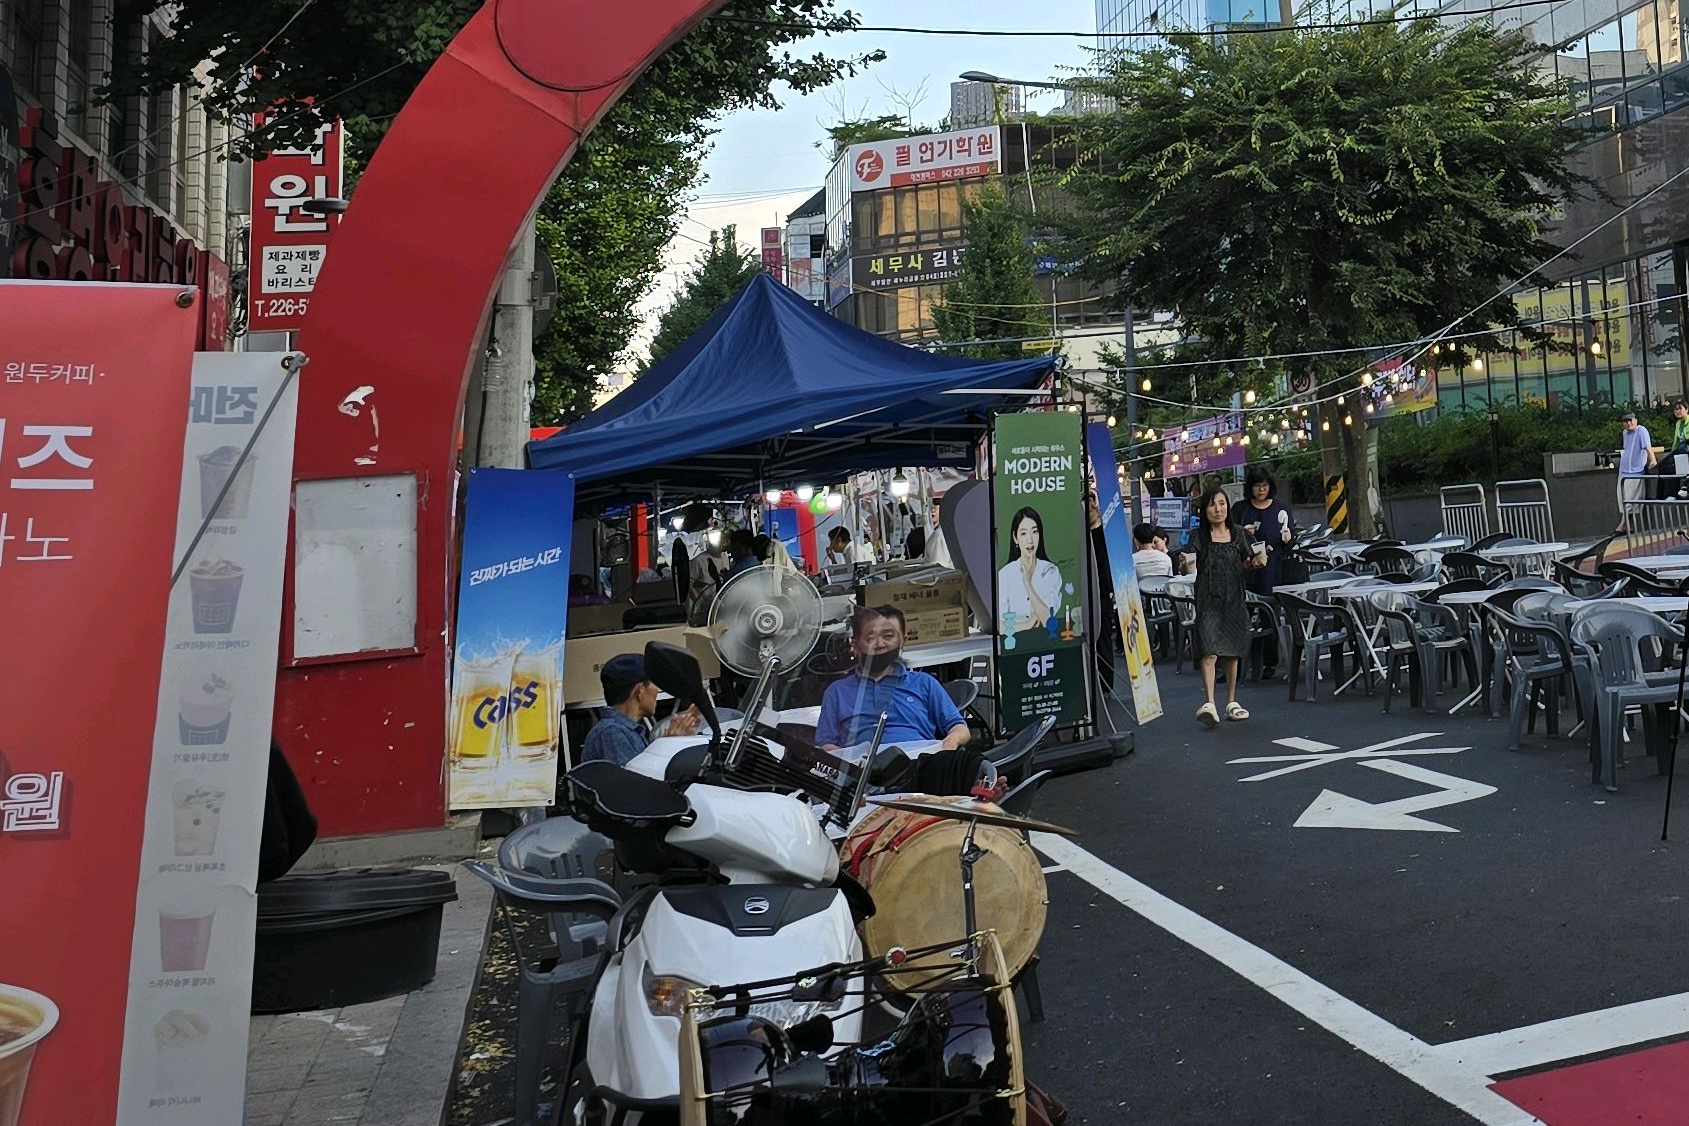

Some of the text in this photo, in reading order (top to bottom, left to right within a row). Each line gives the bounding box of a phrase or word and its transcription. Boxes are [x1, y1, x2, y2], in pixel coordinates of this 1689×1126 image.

[896, 134, 993, 167] 필 연기학원
[267, 249, 321, 262] 제과제빵
[869, 253, 923, 275] 세무사
[254, 298, 310, 317] T.226-5
[0, 417, 94, 490] 즈
[1004, 455, 1072, 475] MODERN
[1011, 475, 1066, 494] HOUSE
[469, 546, 562, 587] 진짜가 되는 시간
[1027, 654, 1054, 678] 6F
[1, 770, 64, 833] 원
